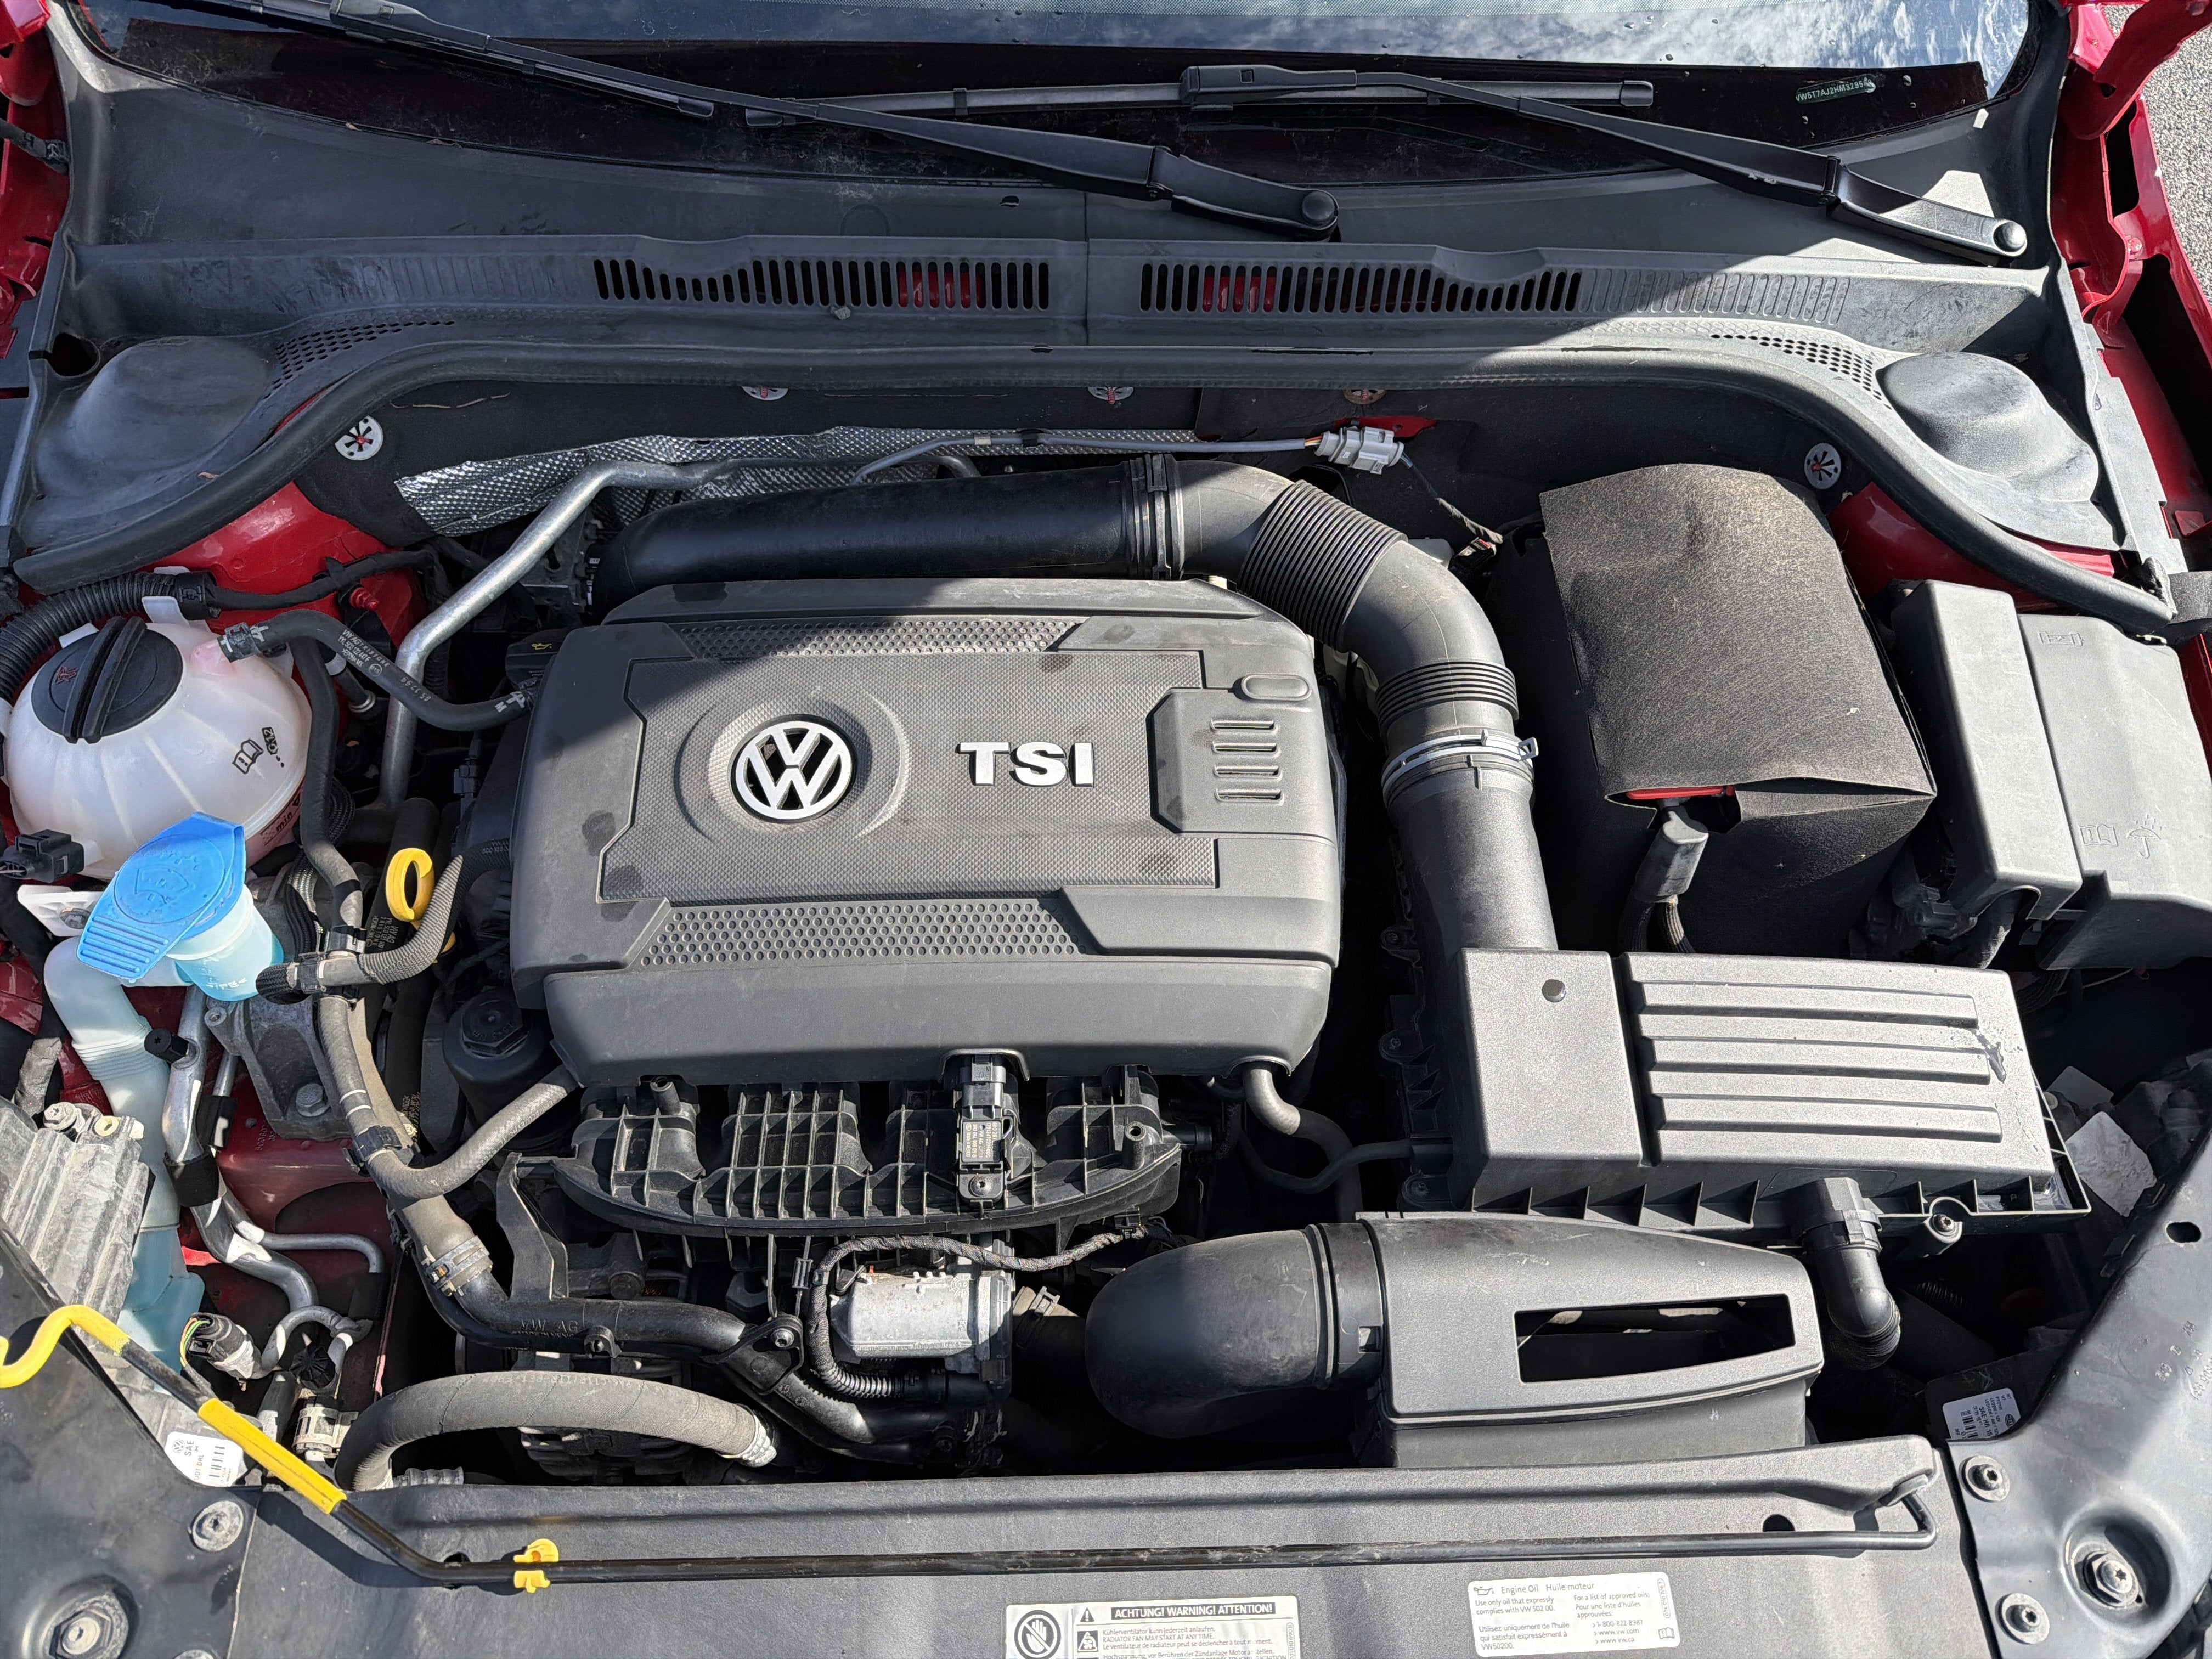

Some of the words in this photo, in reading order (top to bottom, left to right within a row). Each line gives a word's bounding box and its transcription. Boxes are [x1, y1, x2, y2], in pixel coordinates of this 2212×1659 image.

[958, 742, 1094, 787] TSI
[276, 812, 292, 832] min
[1983, 1419, 1990, 1427] HR
[184, 1440, 194, 1456] SAE
[1501, 1587, 1526, 1595] Engine
[1526, 1596, 1554, 1604] expressly
[1609, 1592, 1636, 1600] approved
[1115, 1606, 1165, 1618] ACHTUNG!
[1166, 1605, 1216, 1616] WARNING!
[1218, 1604, 1272, 1615] ATTENTION!
[1517, 1631, 1561, 1640] expressément
[1195, 1649, 1228, 1657] Zündanlage
